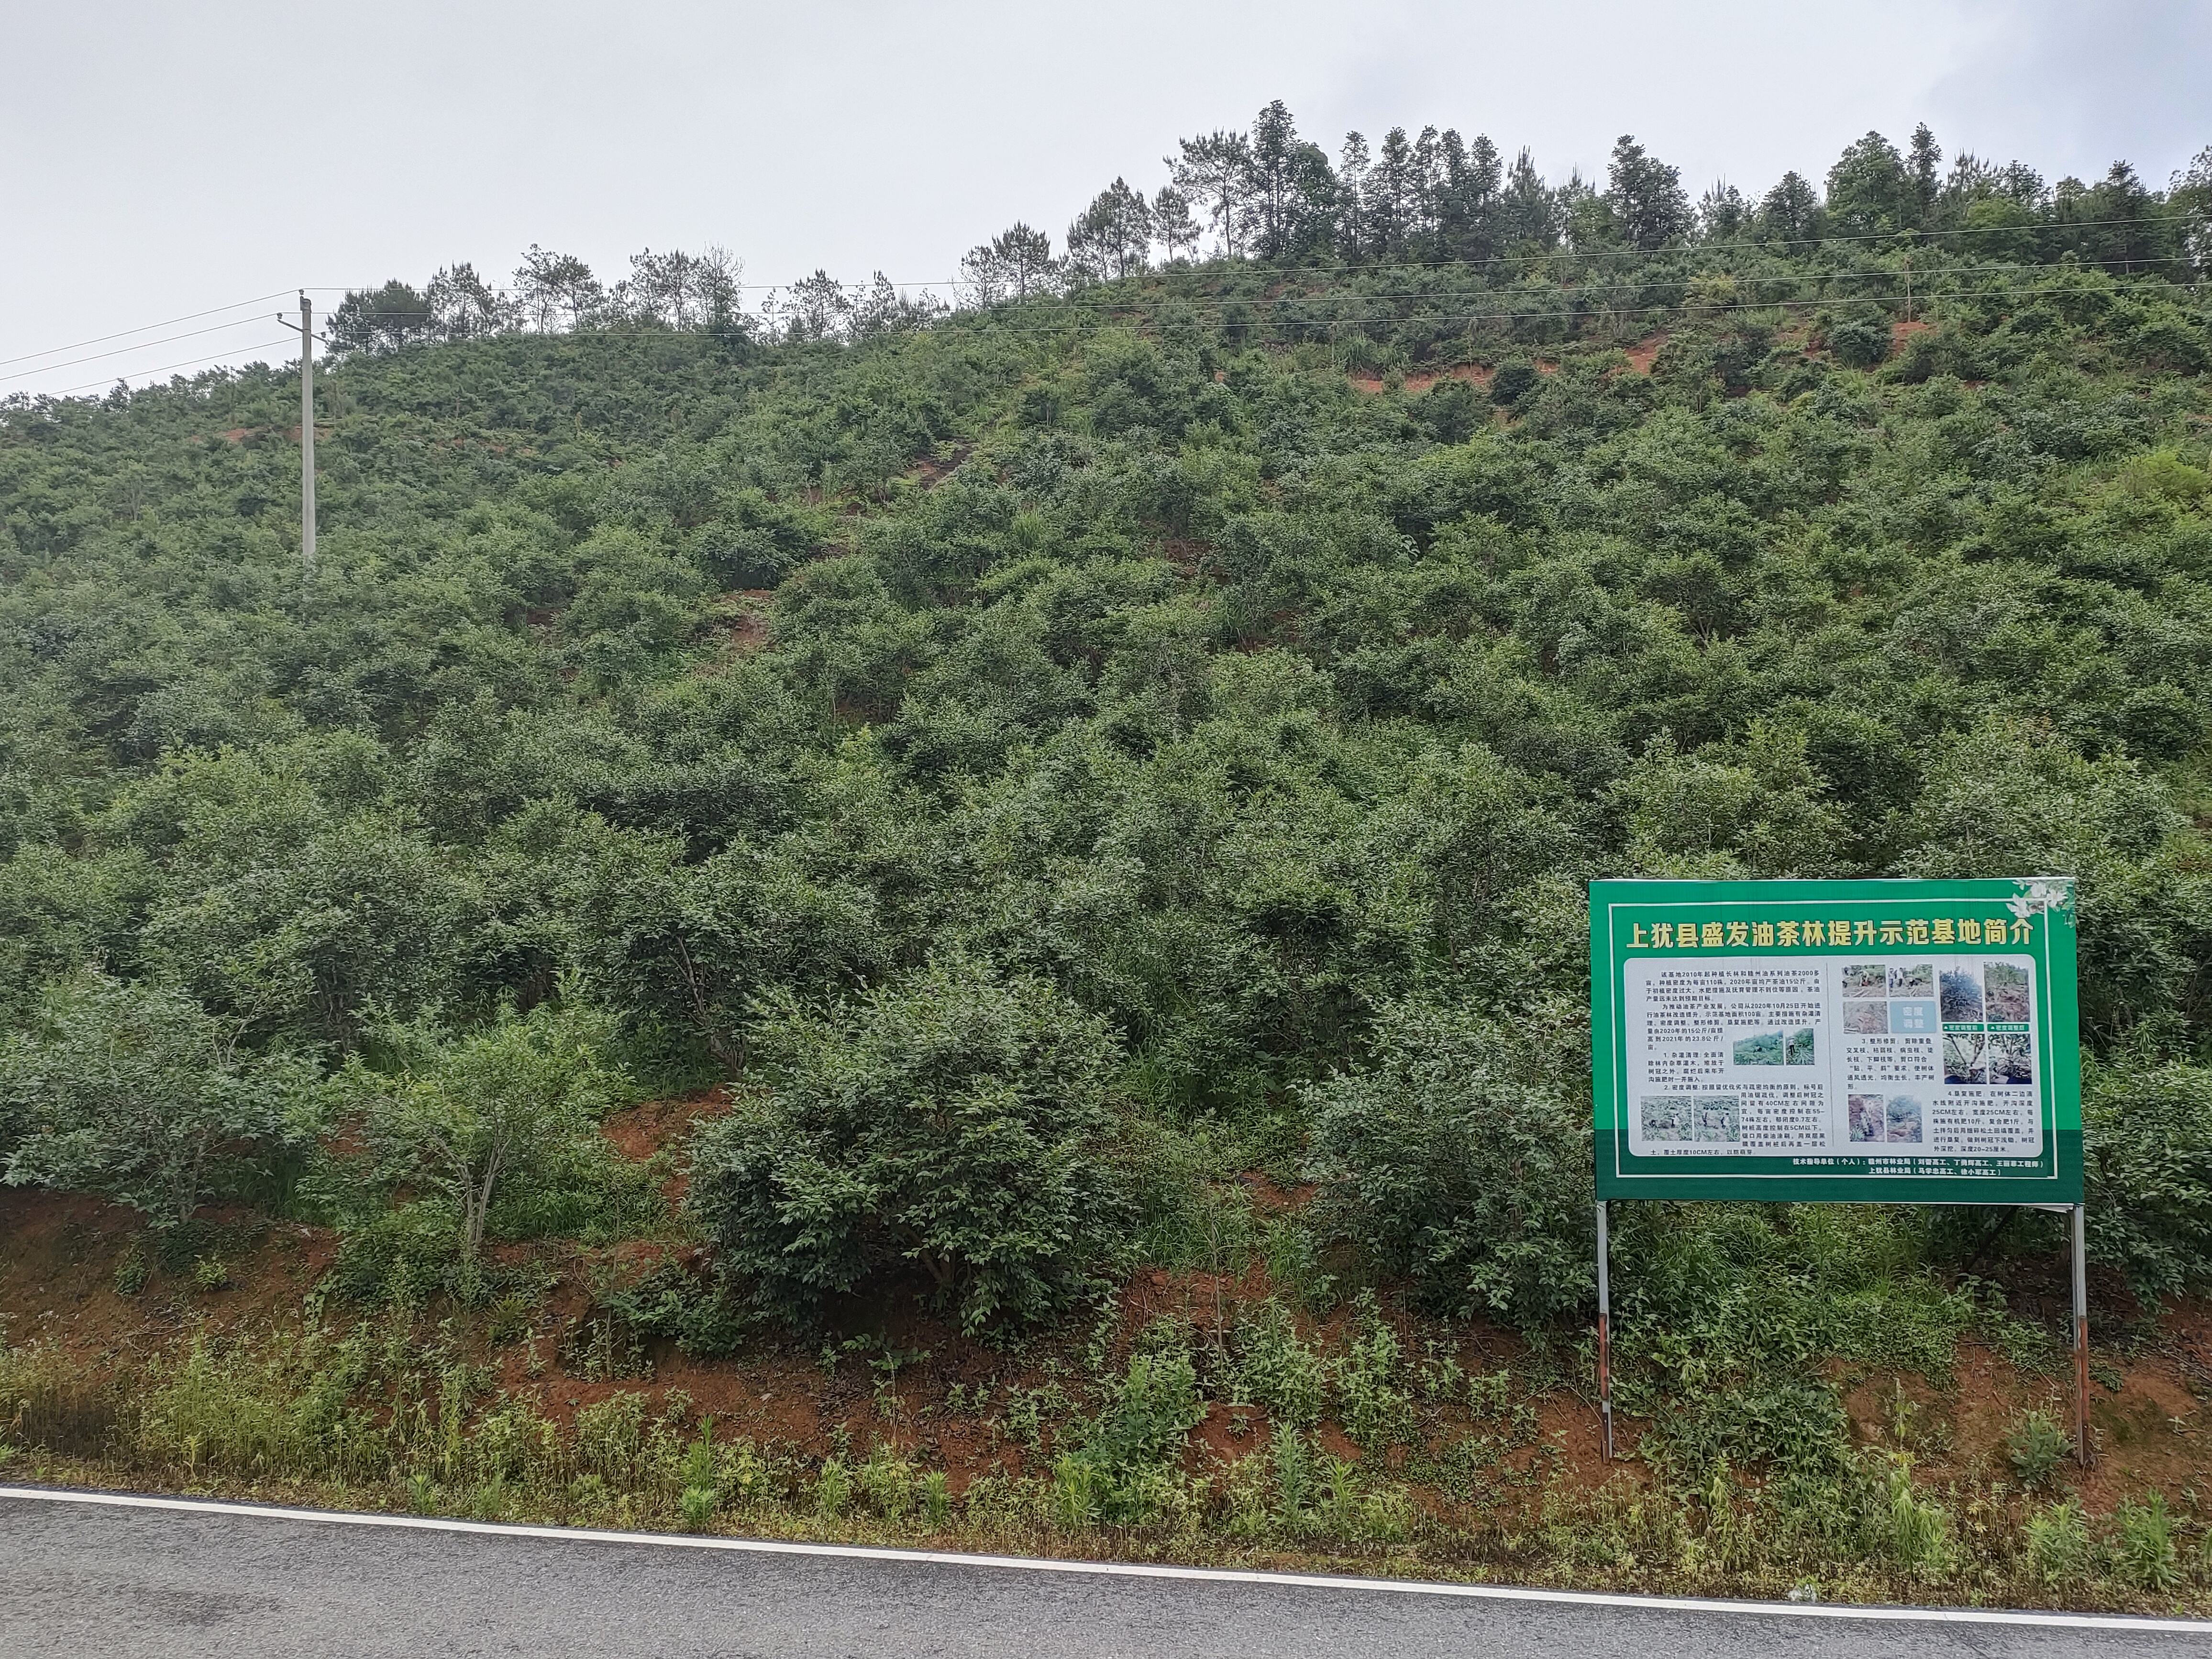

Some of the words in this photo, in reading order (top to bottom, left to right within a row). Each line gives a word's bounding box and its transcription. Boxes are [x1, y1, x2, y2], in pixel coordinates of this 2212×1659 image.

[1626, 917, 2034, 948] 上犹县盛发油茶林提升示范基地简介
[1902, 1006, 1923, 1016] 密度
